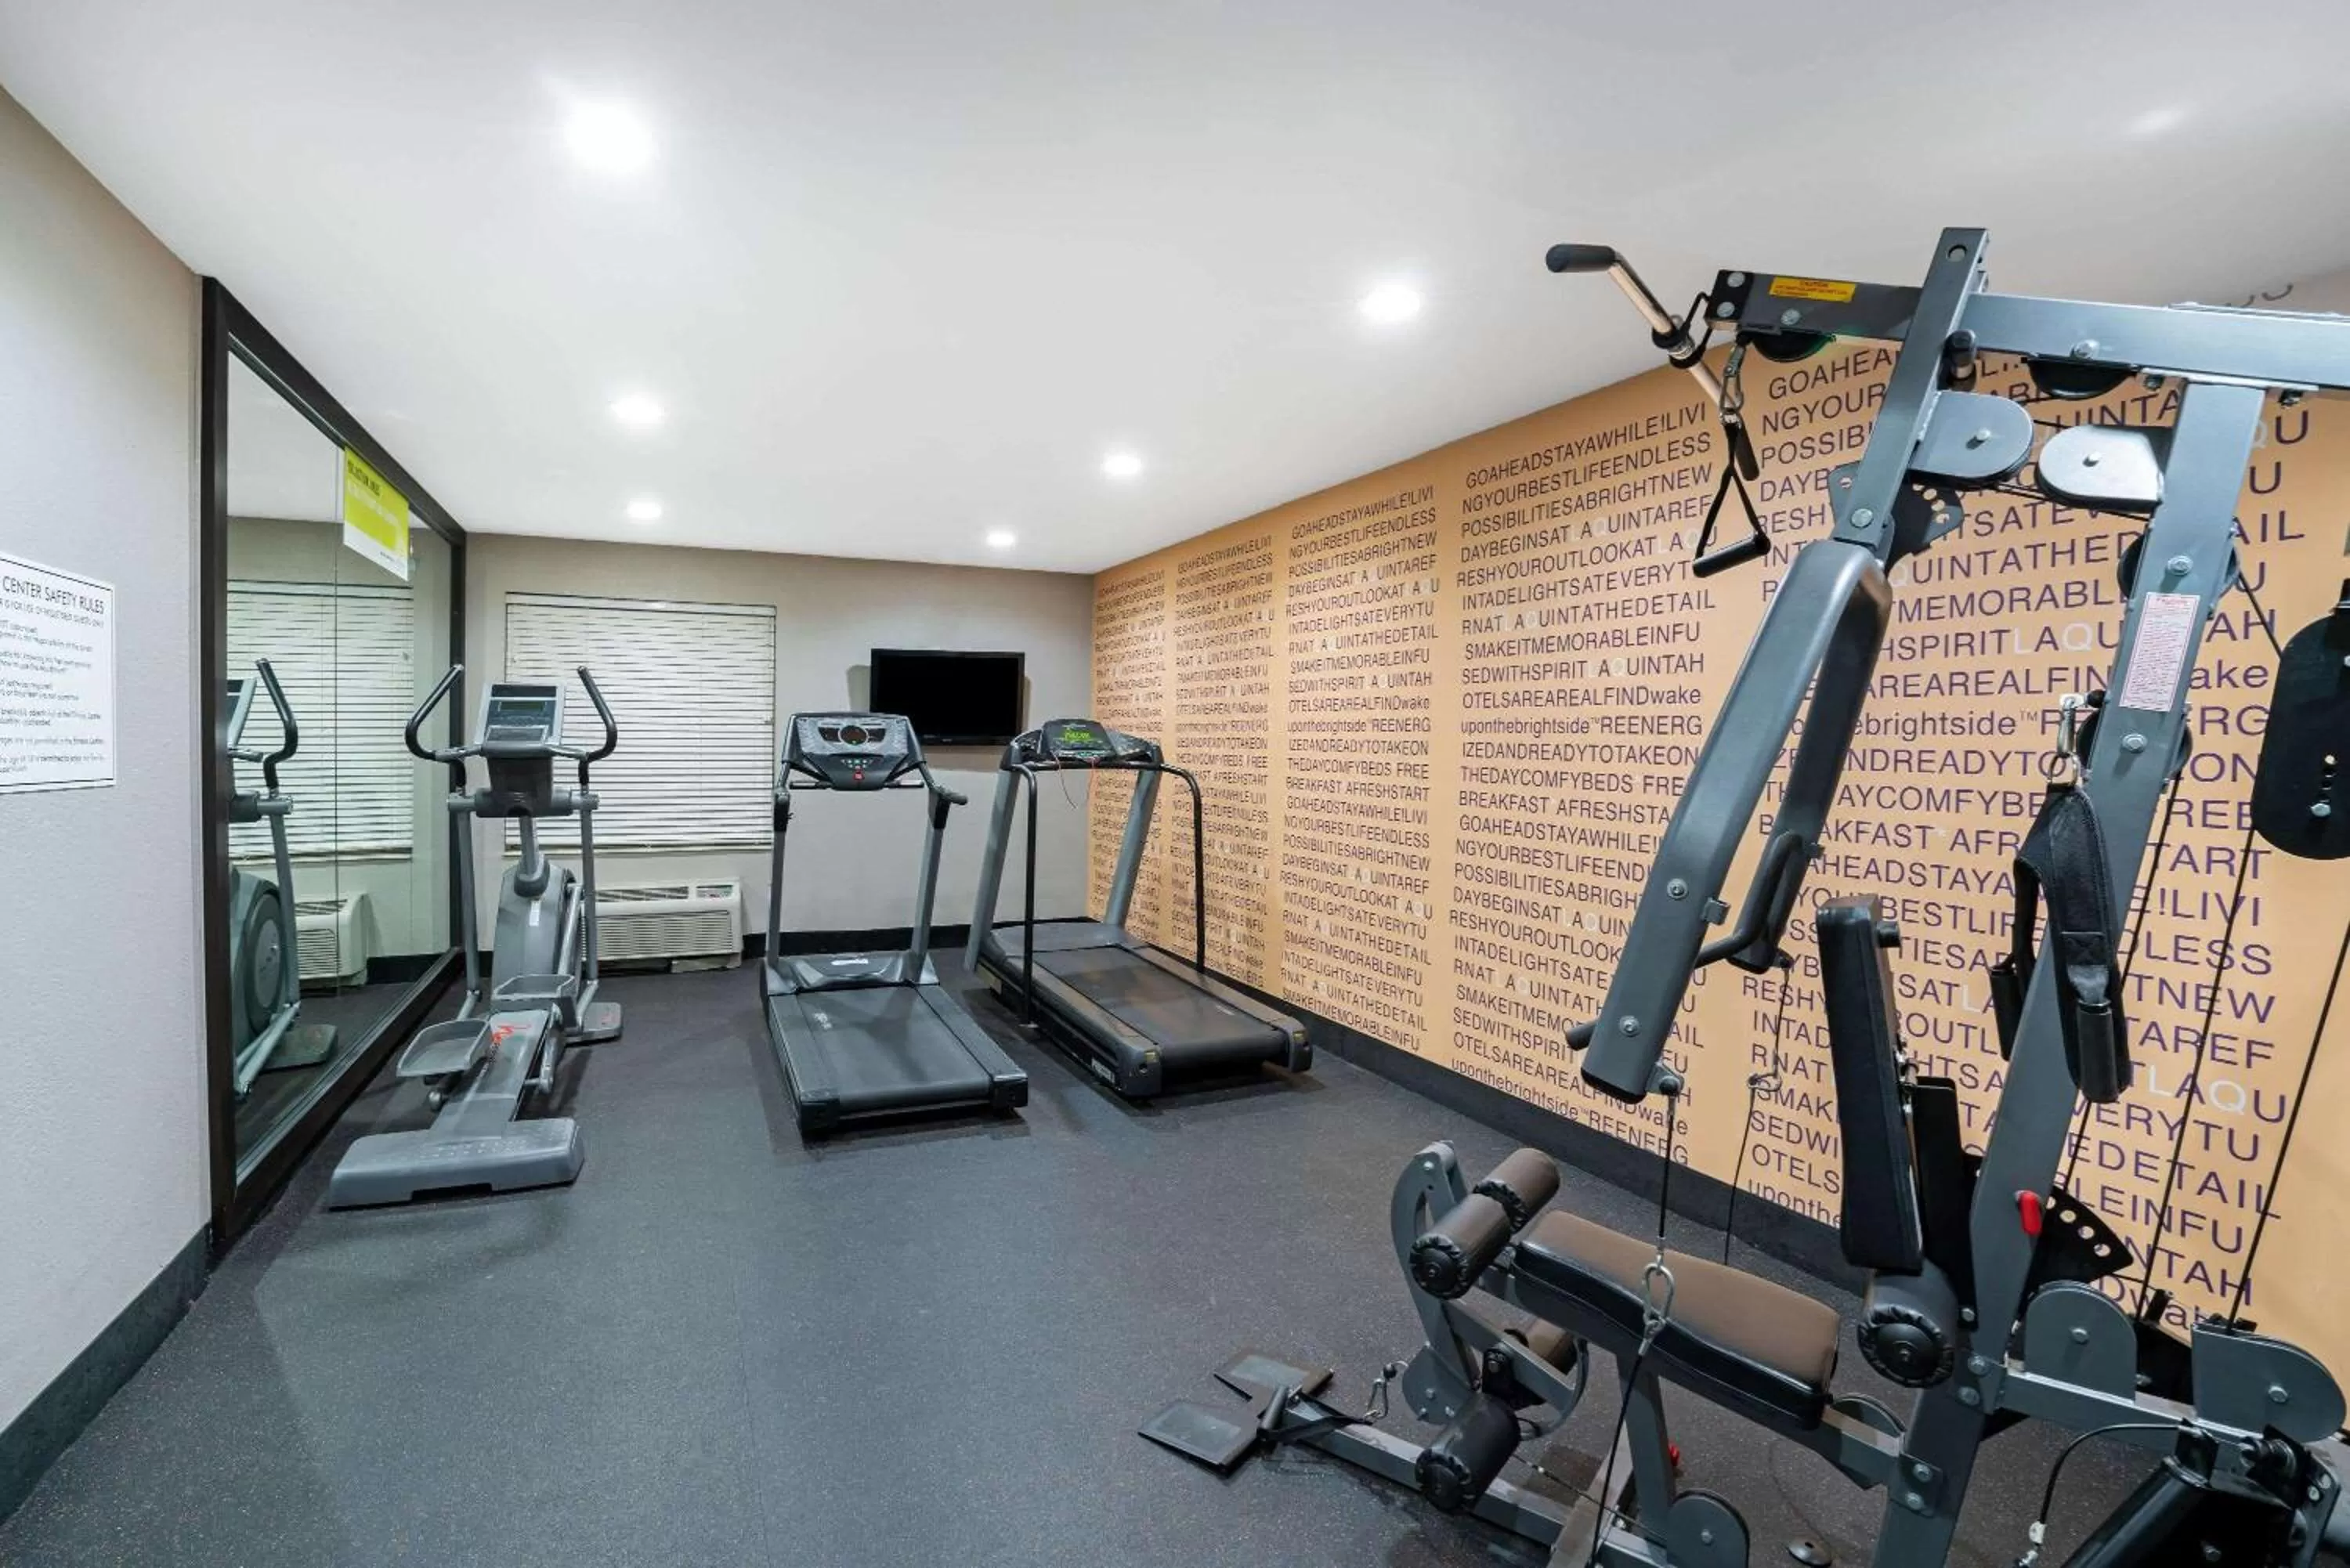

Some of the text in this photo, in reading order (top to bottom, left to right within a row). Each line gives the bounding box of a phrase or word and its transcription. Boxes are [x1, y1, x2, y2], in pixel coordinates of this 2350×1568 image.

[1769, 348, 1893, 399] GOAHEA
[1466, 402, 1706, 490] GOAHEADSTAYAWHILE!LIVI
[1761, 421, 1871, 468] POSSIB
[1462, 432, 1711, 515] NGYOURBESTLIFEENDLESS
[1461, 462, 1712, 538] POSSIBILITIESABRIGHTNEW
[3, 576, 104, 614] CENTER SAFETY RULES
[1462, 561, 1694, 609] INTADELIGHTSATEVERYT
[1894, 578, 2125, 623] MEMORABL
[1465, 621, 1701, 661] SMAKEITMEMORABLEINFU
[1462, 685, 1701, 709] OTELSAREAREALFINDwake
[1397, 763, 1430, 779] FREE
[1462, 742, 1699, 766] IZEDANDREADYTOTAKEON
[1460, 765, 1684, 797] THEDAYCOMFYBEDS FRE
[1459, 791, 1670, 825] BREAKFAST AFRESHSTA
[1460, 814, 1659, 854] GOAHEADSTAYAWHILE!
[1456, 839, 1649, 882] NGYOURBESTLIFEEND
[1455, 862, 1641, 910] POSSIBILITIESABRIGH
